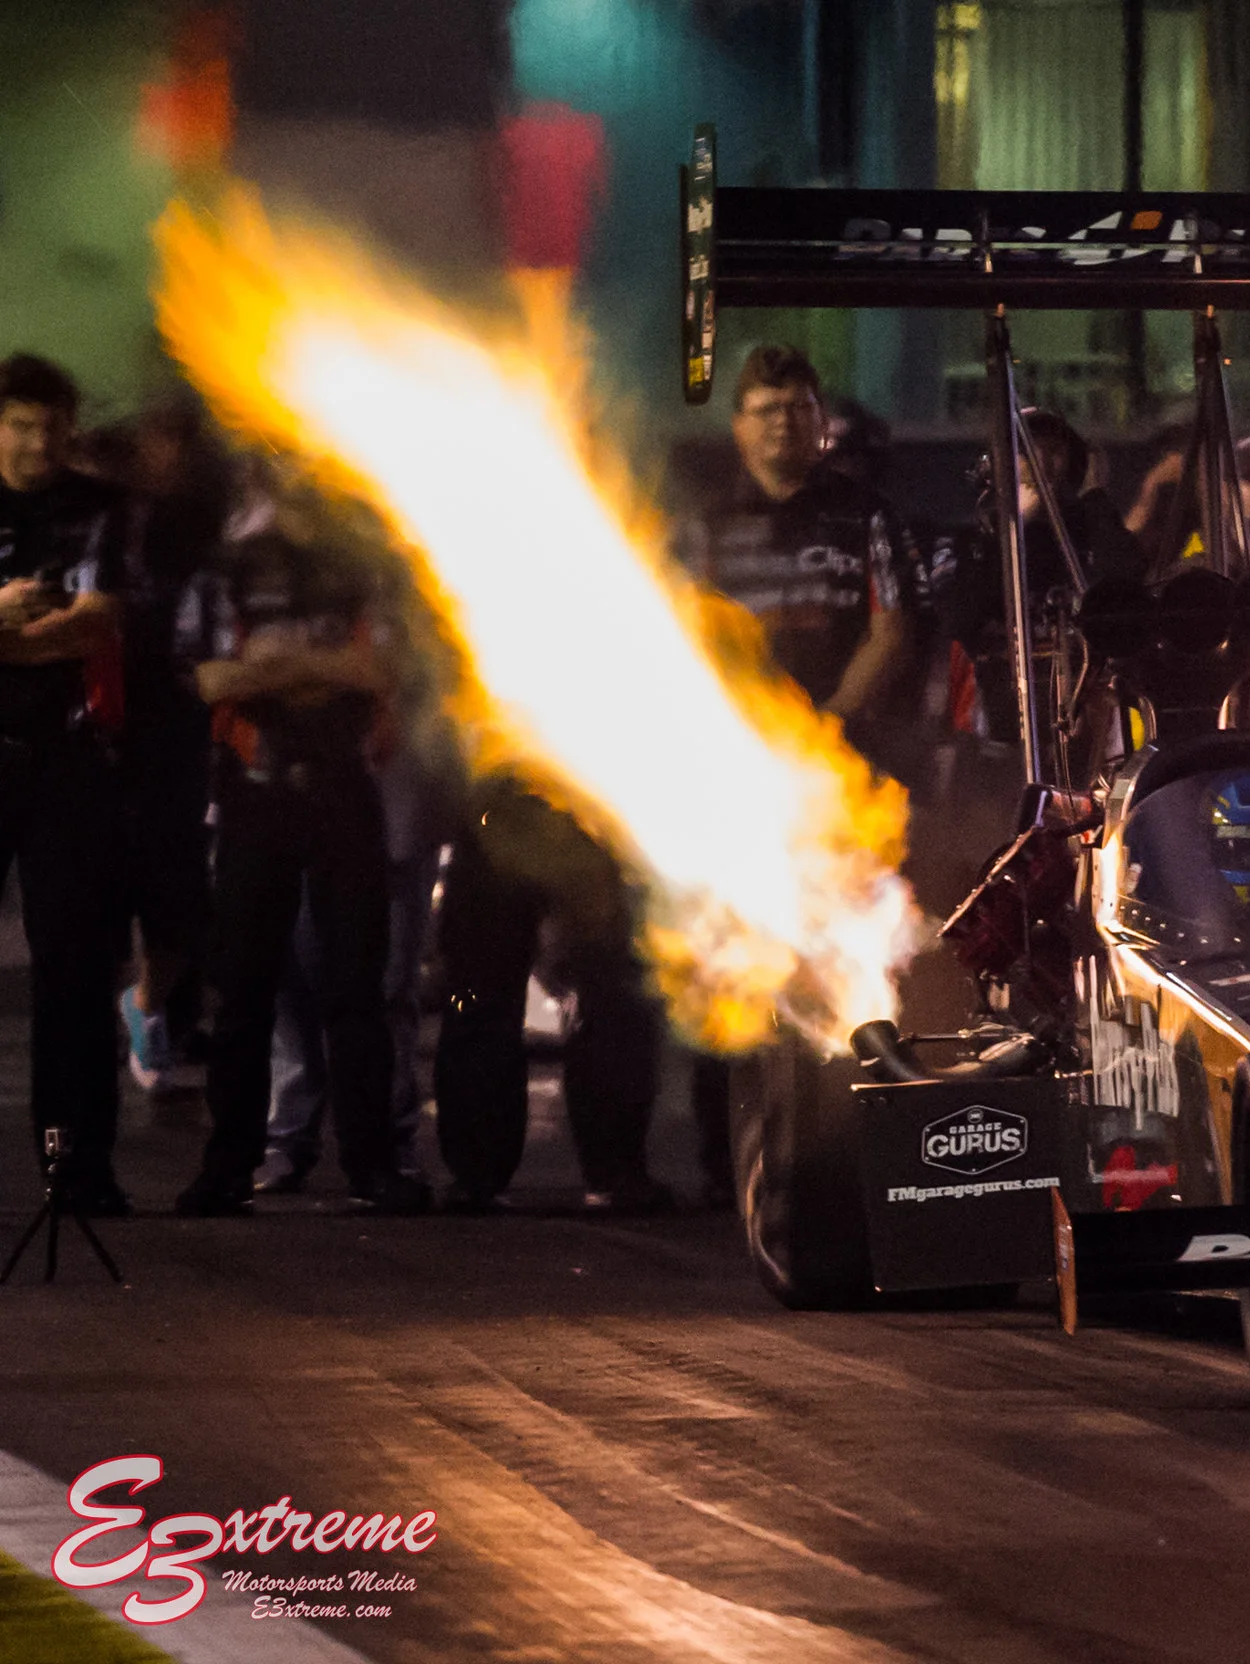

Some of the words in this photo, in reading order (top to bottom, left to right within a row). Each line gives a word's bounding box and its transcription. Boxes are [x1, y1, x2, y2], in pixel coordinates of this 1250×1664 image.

[949, 1122, 1002, 1134] GARAGE
[927, 1128, 1022, 1158] GURUS
[887, 1176, 1060, 1203] FMgaragegurus.com
